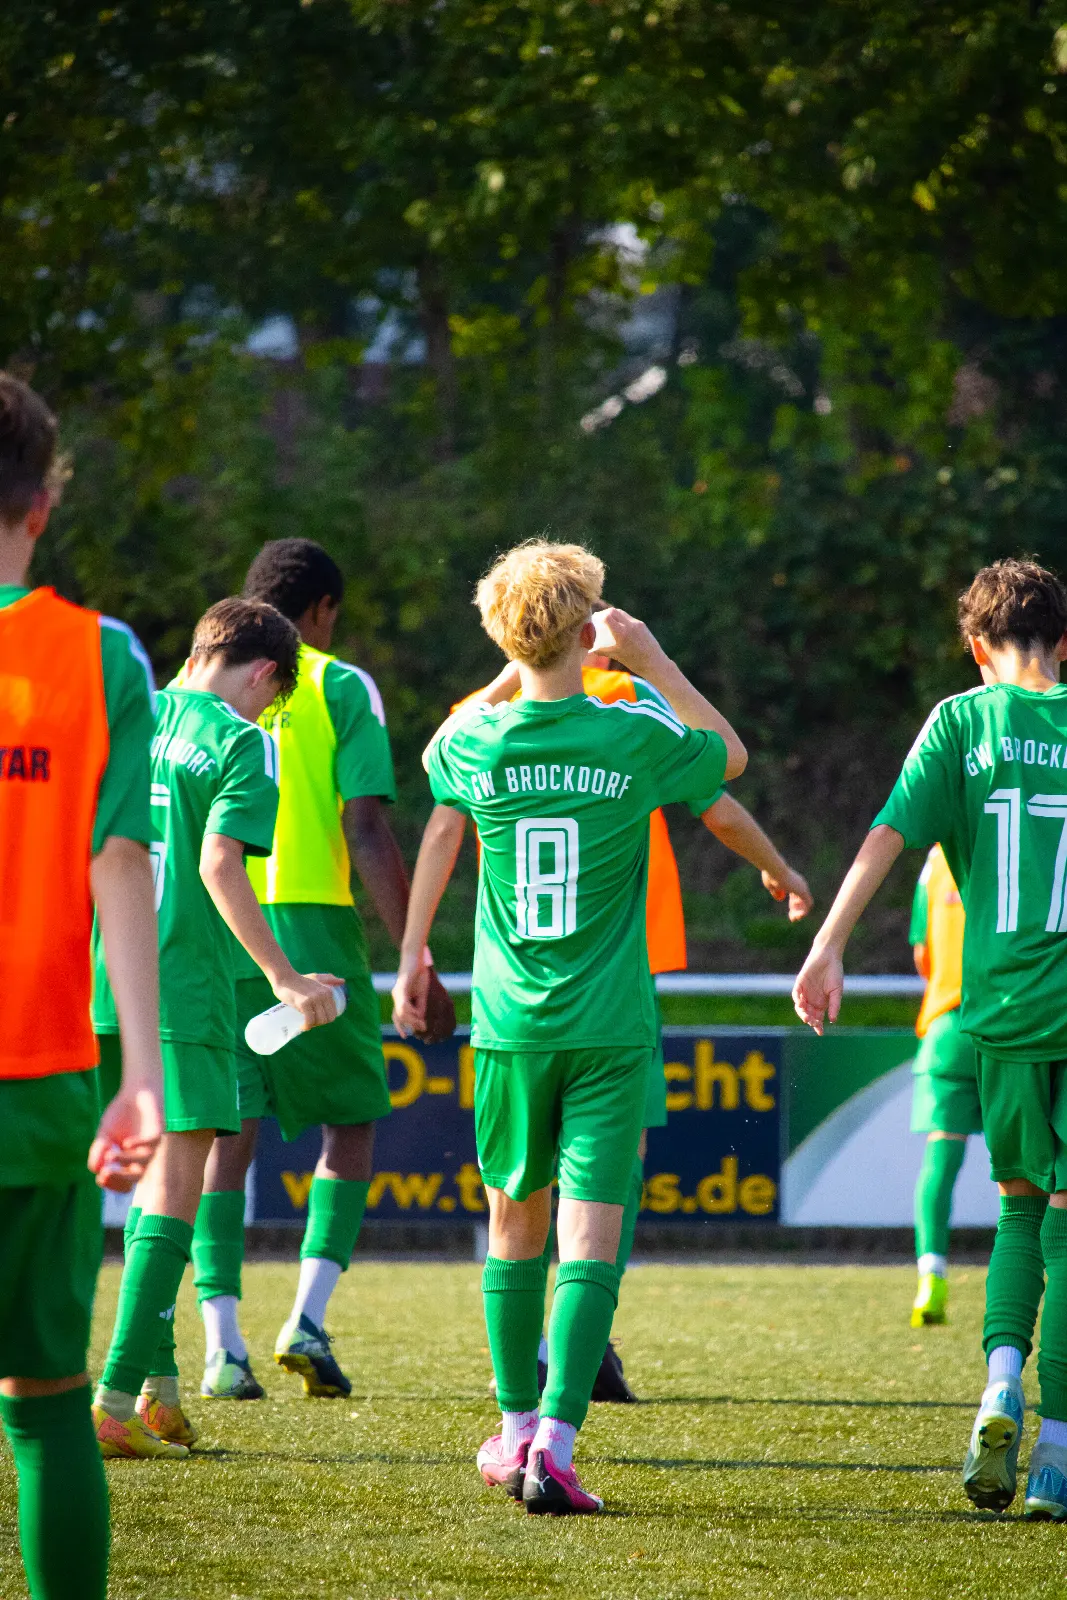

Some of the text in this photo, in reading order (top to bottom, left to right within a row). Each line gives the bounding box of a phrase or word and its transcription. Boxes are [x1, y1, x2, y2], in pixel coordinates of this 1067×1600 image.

[471, 764, 632, 801] GW BROCKDORF
[966, 736, 1067, 777] GW BROCK
[515, 817, 579, 938] 8
[984, 788, 1067, 933] 17
